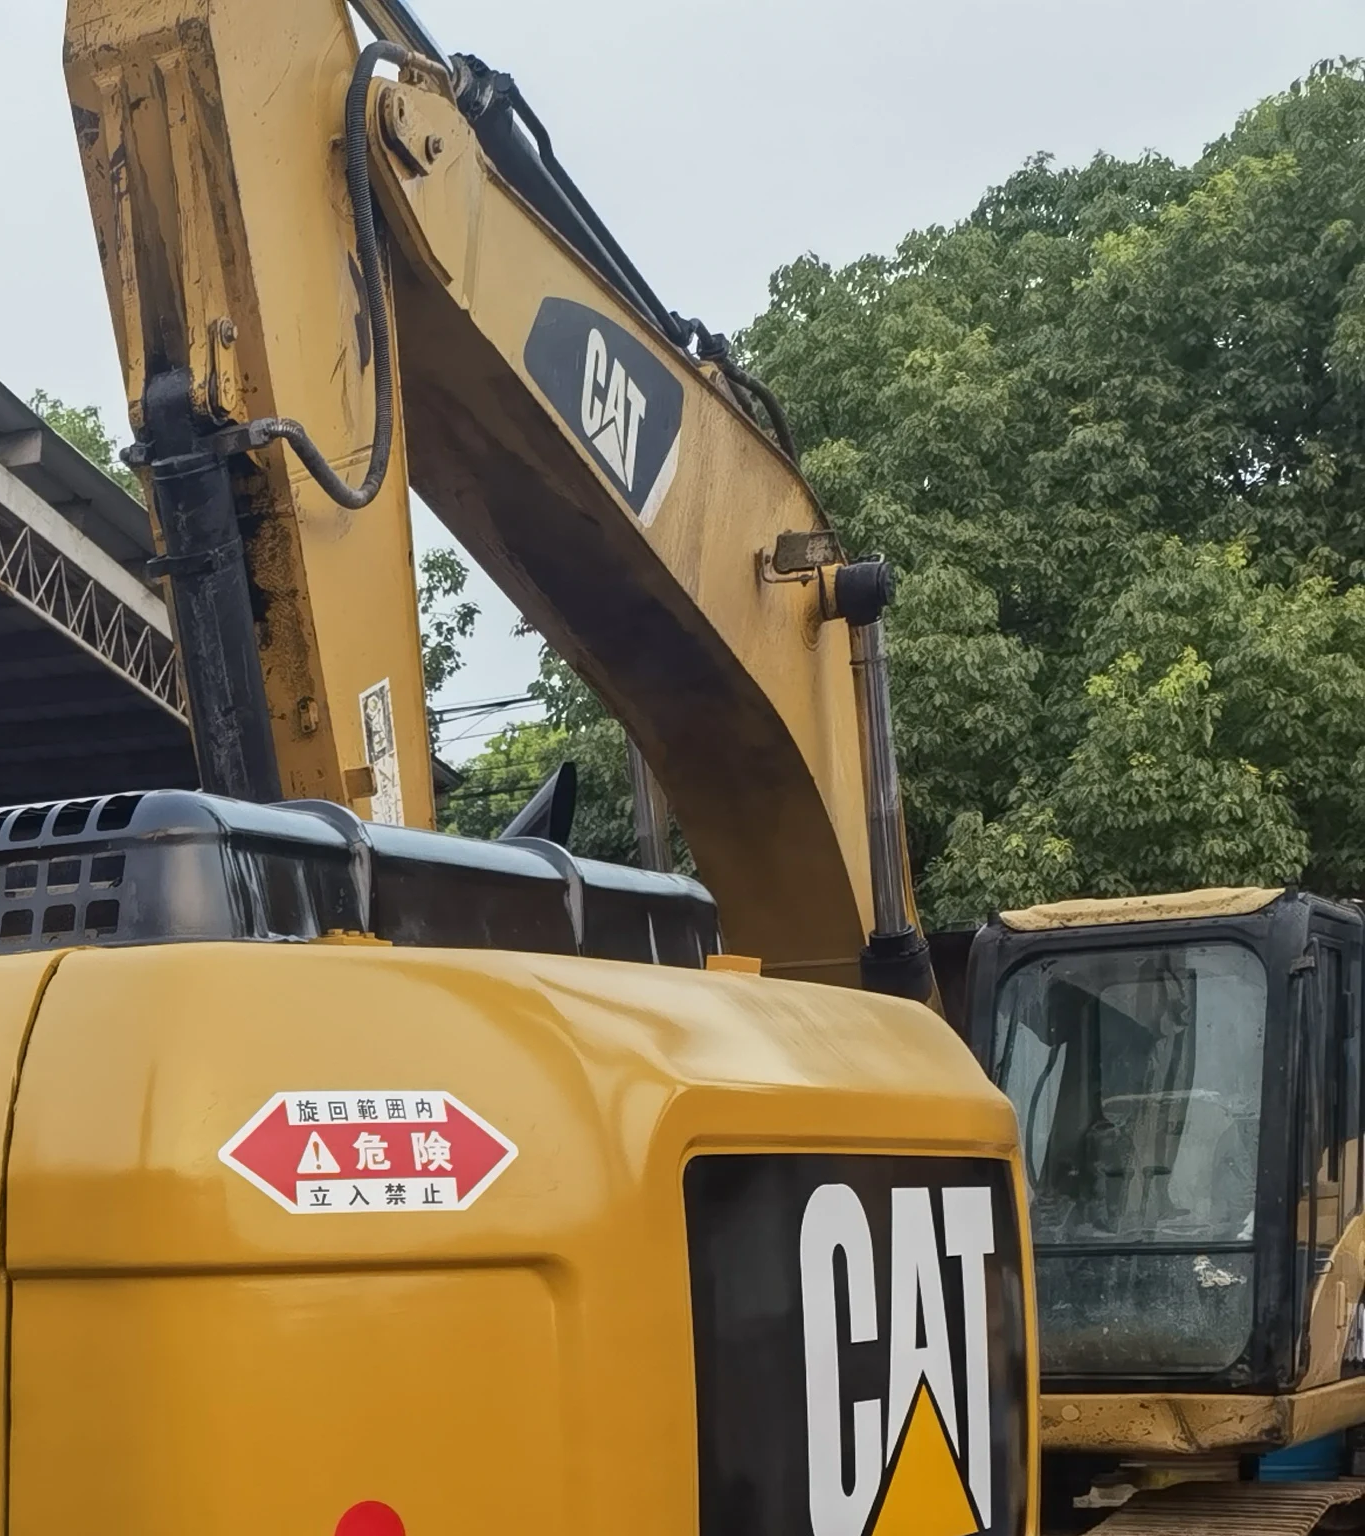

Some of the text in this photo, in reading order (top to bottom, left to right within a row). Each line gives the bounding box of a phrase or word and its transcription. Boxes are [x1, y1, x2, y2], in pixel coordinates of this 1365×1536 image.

[581, 328, 646, 492] CAT
[296, 1098, 434, 1123] 旋回範囲内
[353, 1131, 453, 1172] 危険
[310, 1183, 443, 1207] 立入禁止
